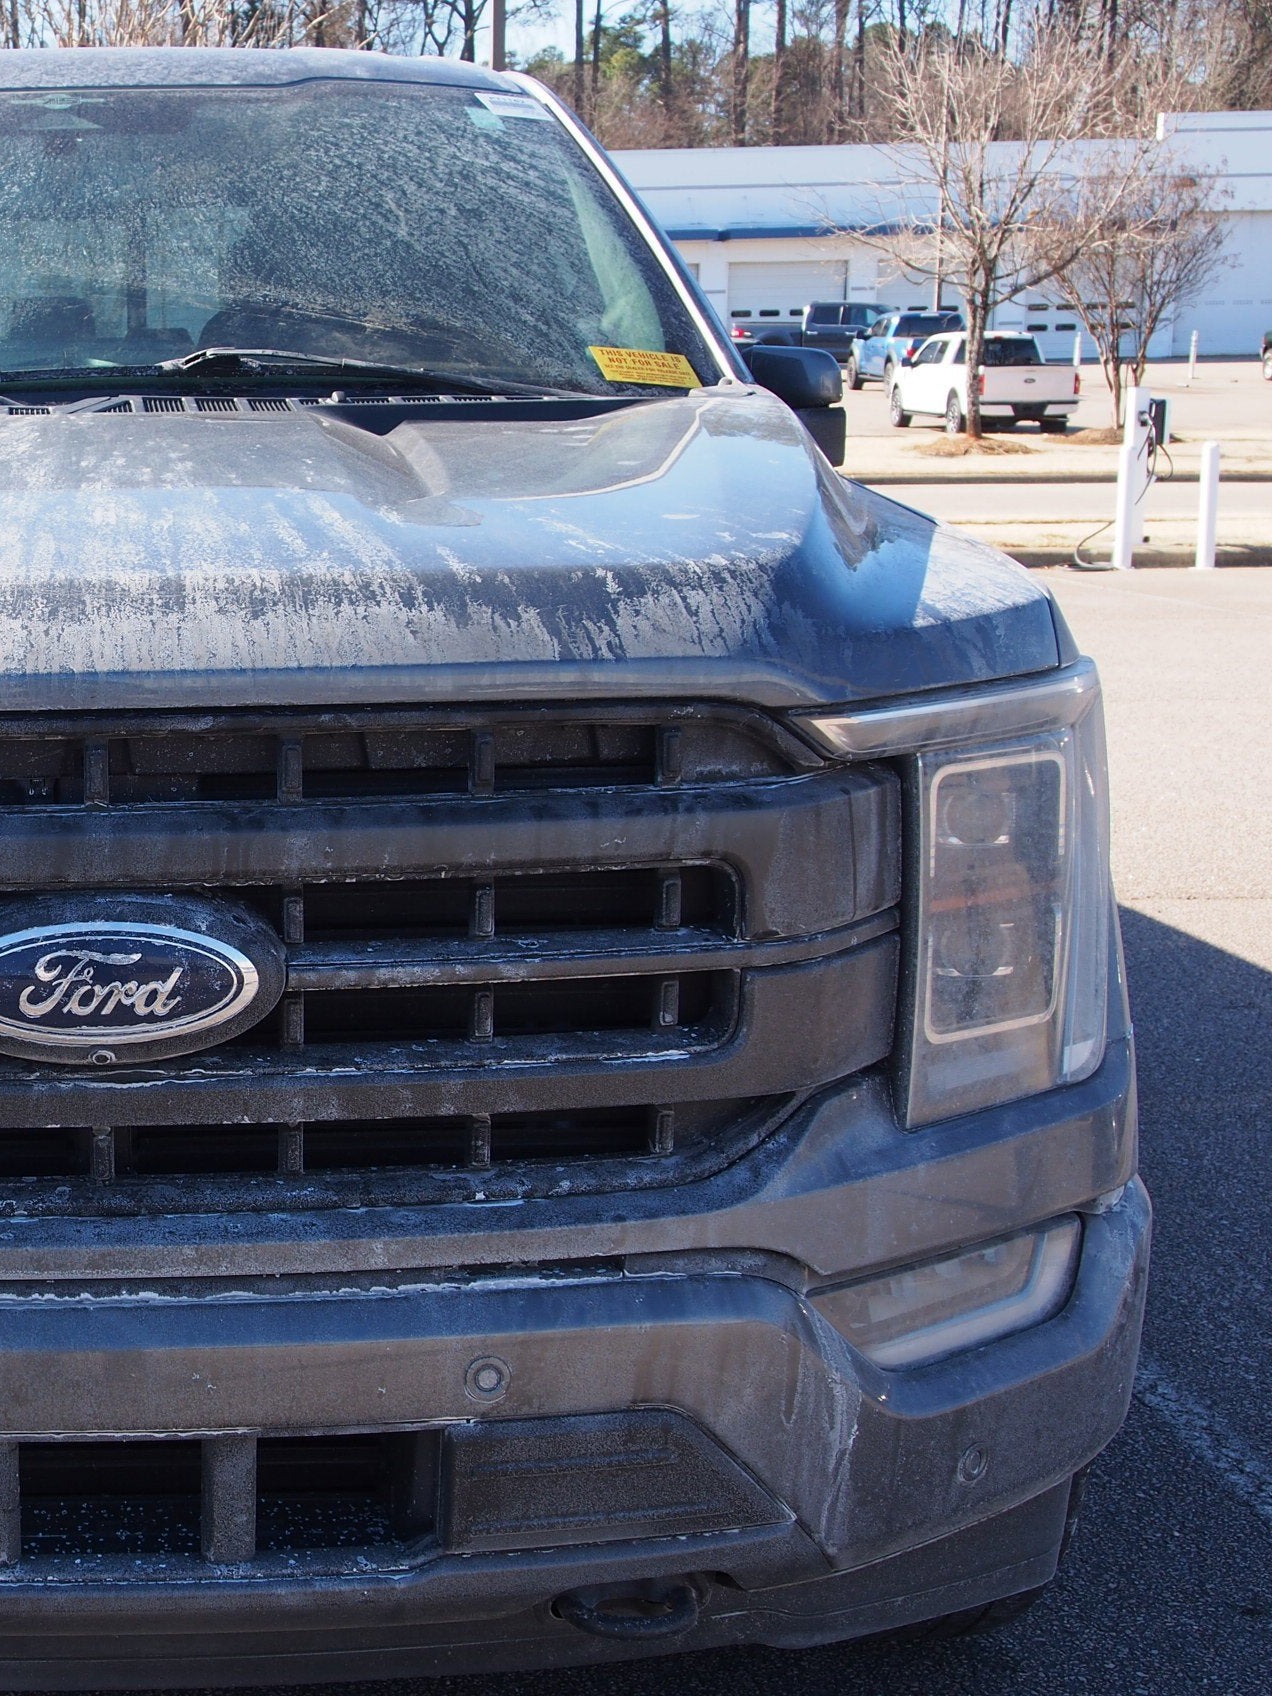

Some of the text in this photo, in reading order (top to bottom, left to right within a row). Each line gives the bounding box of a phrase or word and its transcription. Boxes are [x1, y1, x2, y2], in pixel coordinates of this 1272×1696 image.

[600, 349, 681, 363] THIS VEHICLE IS
[607, 356, 680, 370] NOT FOR SALE
[18, 949, 184, 1017] Ford
